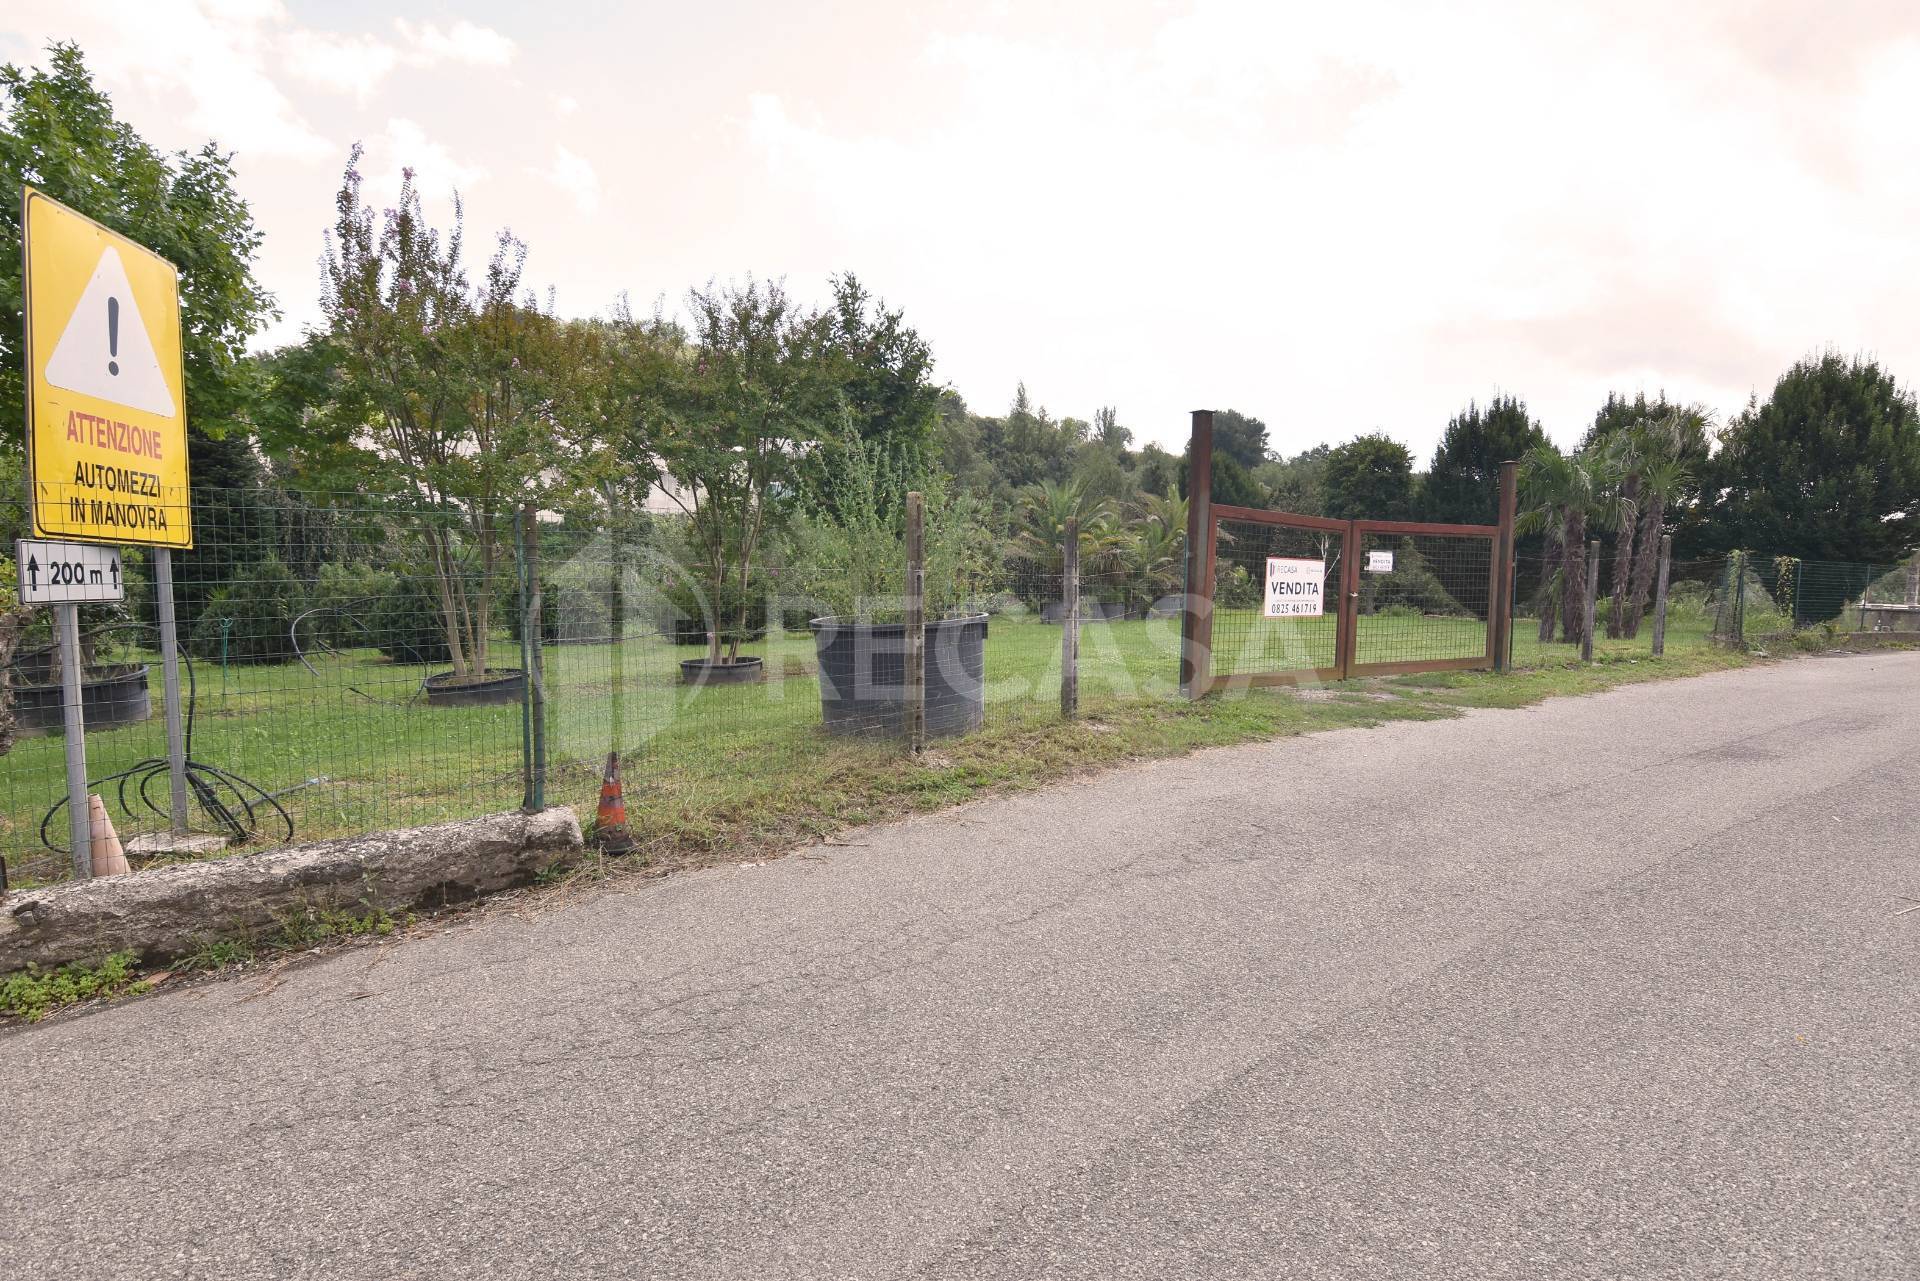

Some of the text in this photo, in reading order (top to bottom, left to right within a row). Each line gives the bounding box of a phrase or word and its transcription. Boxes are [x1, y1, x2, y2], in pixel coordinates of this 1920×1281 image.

[67, 410, 163, 460] ATTENZIONE
[74, 460, 161, 498] AUTOMEZZI
[70, 496, 168, 531] IN MANOVRA
[50, 561, 103, 585] 200 m
[1271, 581, 1319, 595] VENDITA
[1271, 603, 1317, 614] 0825 461719
